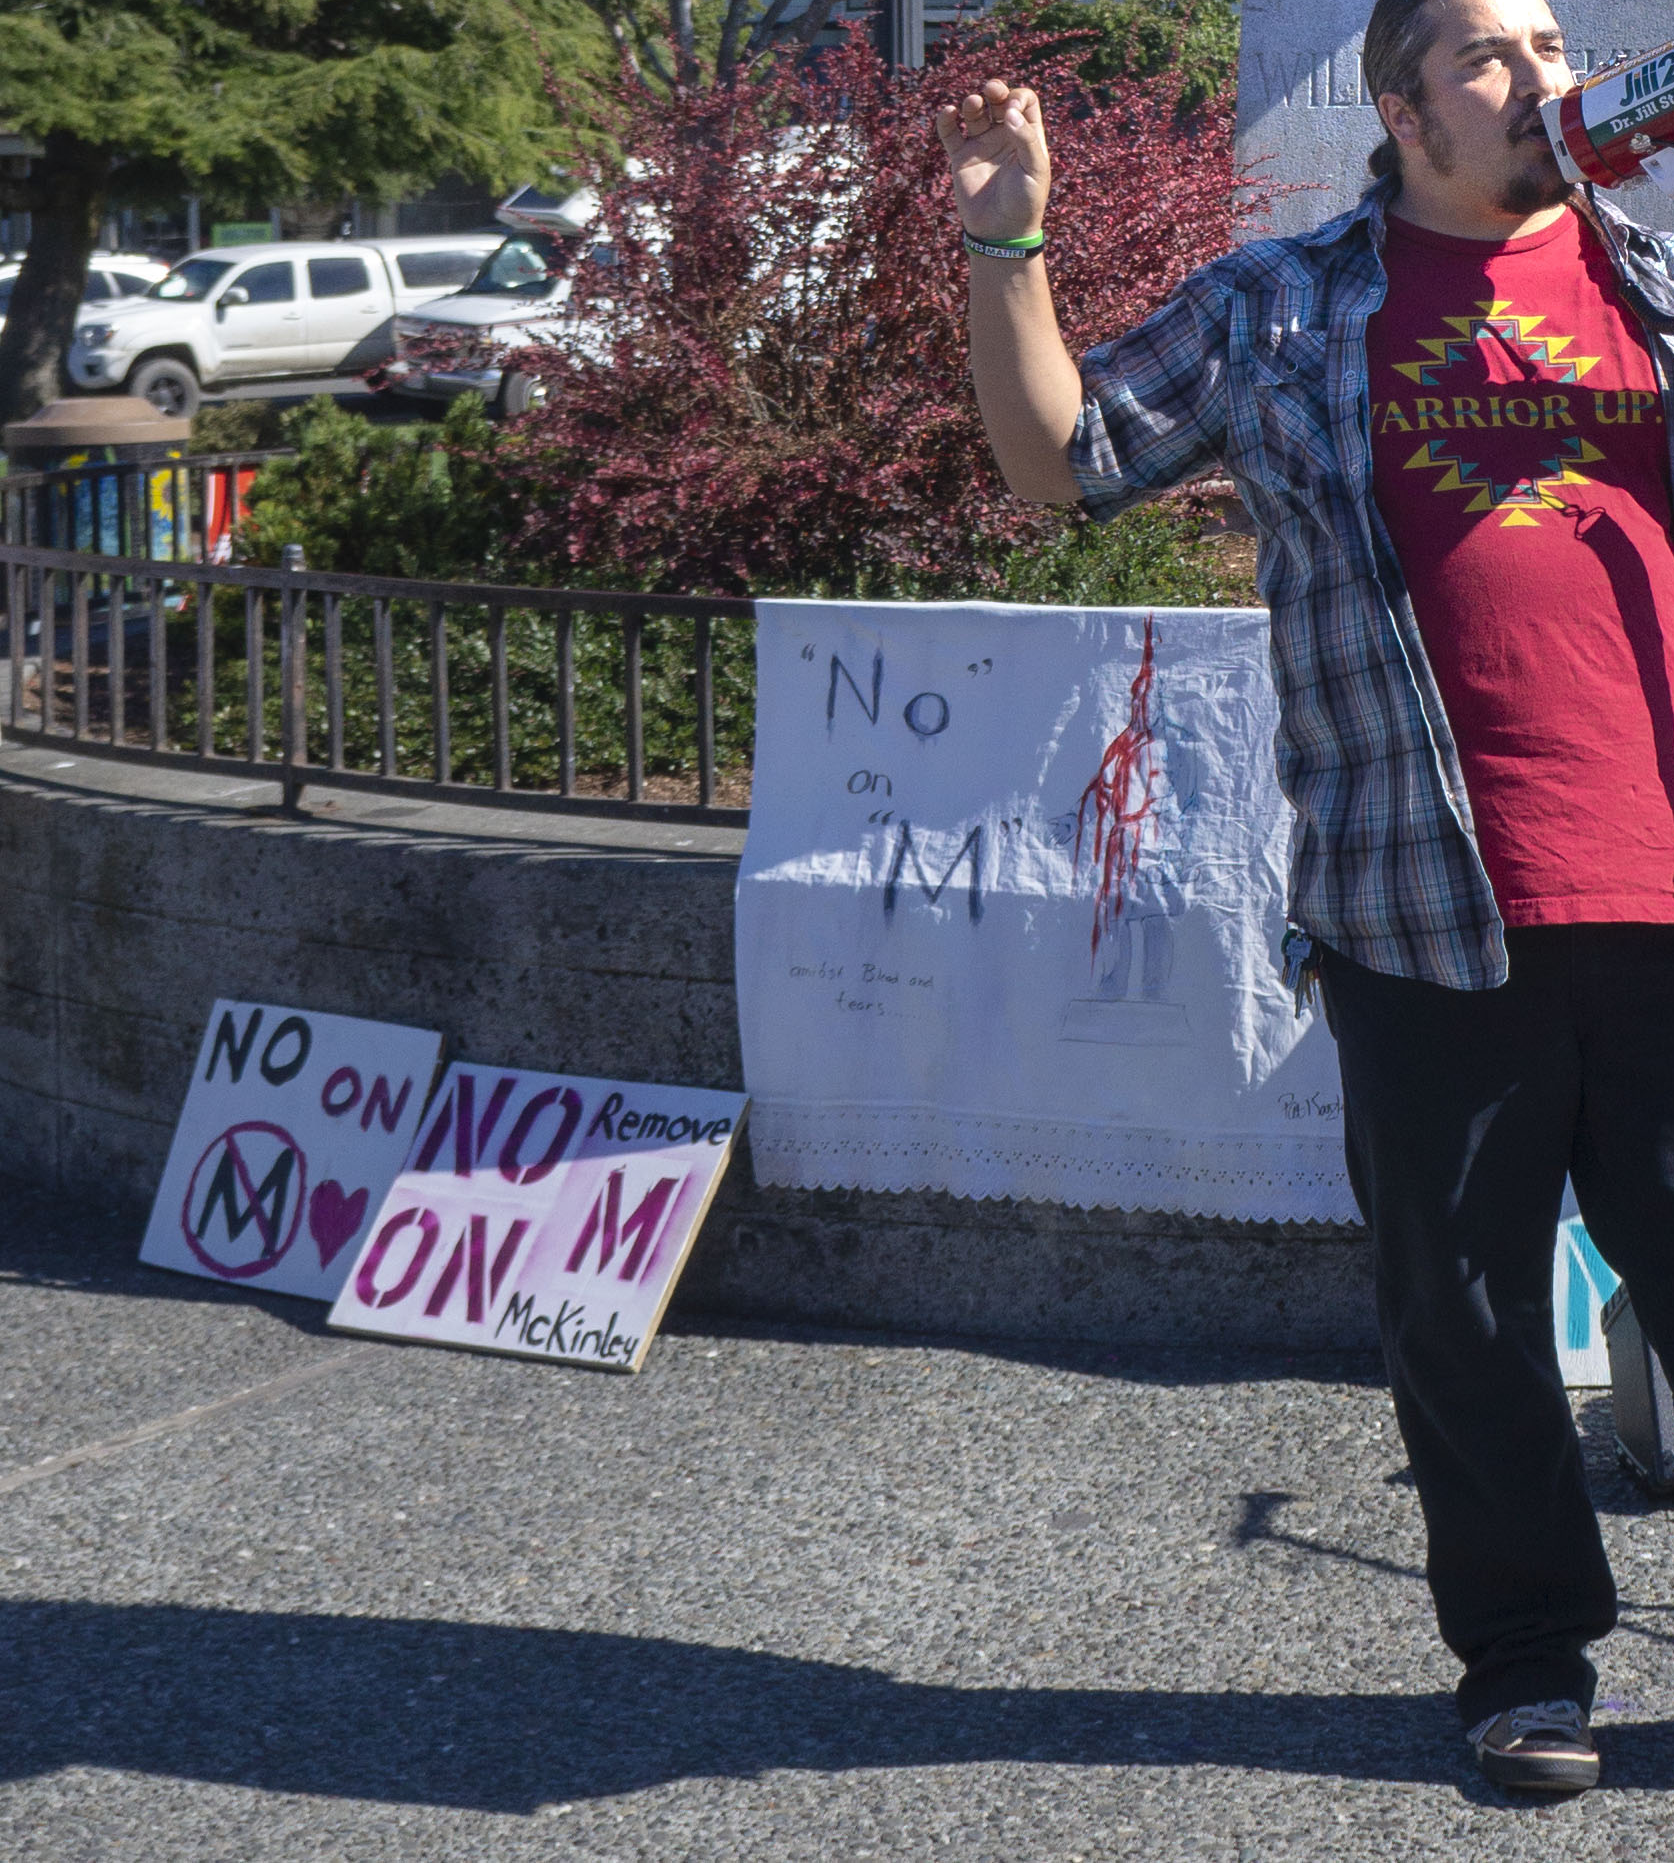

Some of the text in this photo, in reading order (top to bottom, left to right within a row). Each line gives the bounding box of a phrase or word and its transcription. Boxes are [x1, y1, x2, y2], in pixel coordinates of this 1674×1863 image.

[1609, 117, 1634, 135] Dr.
[1634, 102, 1658, 124] Jill
[1593, 391, 1663, 425] UP.
[846, 769, 893, 798] on
[204, 1007, 414, 1134] NO ON
[413, 1073, 584, 1187] NO
[586, 1091, 732, 1147] Remove
[563, 1164, 681, 1281] M
[355, 1207, 532, 1324] ON
[494, 1290, 640, 1366] McKinley
